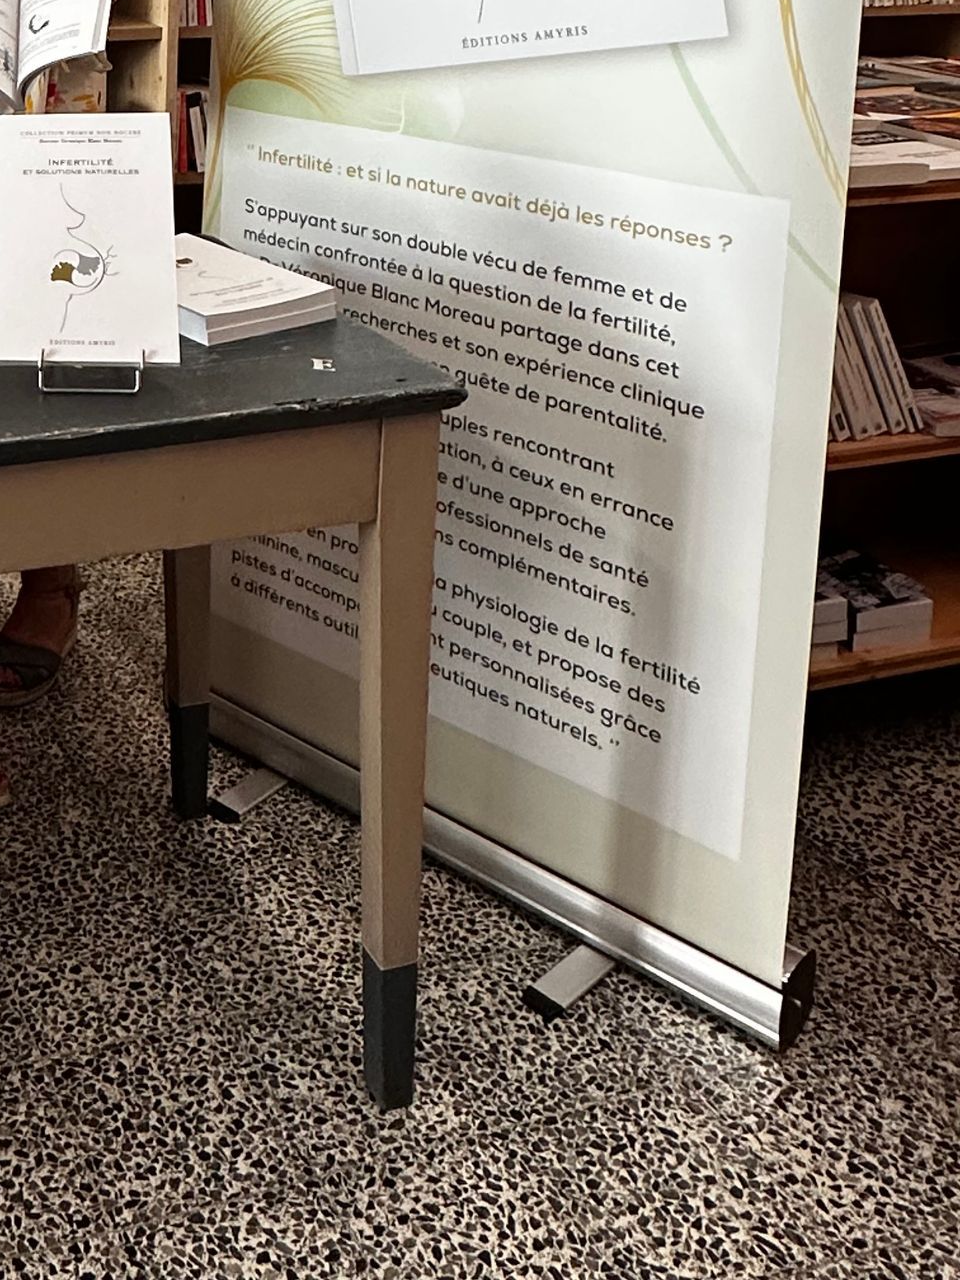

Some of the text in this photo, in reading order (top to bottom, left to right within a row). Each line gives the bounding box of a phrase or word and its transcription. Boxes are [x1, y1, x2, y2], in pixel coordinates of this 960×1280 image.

[461, 25, 588, 50] ÉDITIONS AMYRIS
[48, 158, 113, 166] INFERTILITÉ
[258, 145, 333, 174] Infertilité
[346, 164, 364, 180] et
[368, 166, 381, 183] si
[386, 169, 401, 187] la
[406, 177, 467, 200] nature
[471, 190, 522, 211] avait
[525, 197, 570, 223] déjà
[576, 205, 605, 227] les
[607, 215, 712, 249] réponses
[718, 234, 733, 253] ?
[244, 228, 675, 347] médecin confrontée à la question de la fertilité,
[245, 198, 687, 312] S'appuyant sur son double vécu de femme et de
[343, 308, 705, 419] recherches et son expérience clinique
[371, 283, 420, 309] Blanc
[425, 296, 495, 329] Moreau
[501, 320, 583, 355] partage
[588, 340, 640, 367] dans
[645, 359, 680, 379] cet
[493, 429, 615, 478] rencontrant
[515, 384, 540, 403] de
[545, 395, 667, 443] parentalité.
[452, 475, 504, 504] d'une
[509, 496, 606, 539] approche
[491, 456, 503, 473] à
[509, 466, 554, 490] ceux
[560, 482, 584, 501] en
[591, 493, 674, 531] errance
[458, 539, 635, 616] complémentaires.
[558, 543, 584, 563] de
[589, 556, 649, 587] santé
[231, 549, 661, 743] pistes d'accomp personnalisées grâce
[231, 573, 240, 587] à
[244, 580, 319, 621] différents
[515, 700, 602, 750] naturels.
[442, 610, 506, 648] couple,
[512, 639, 532, 656] et
[537, 649, 622, 693] propose
[627, 685, 665, 713] des
[452, 583, 559, 636] physiologie
[564, 626, 590, 648] de
[596, 636, 614, 659] la
[619, 648, 700, 694] fertilité
